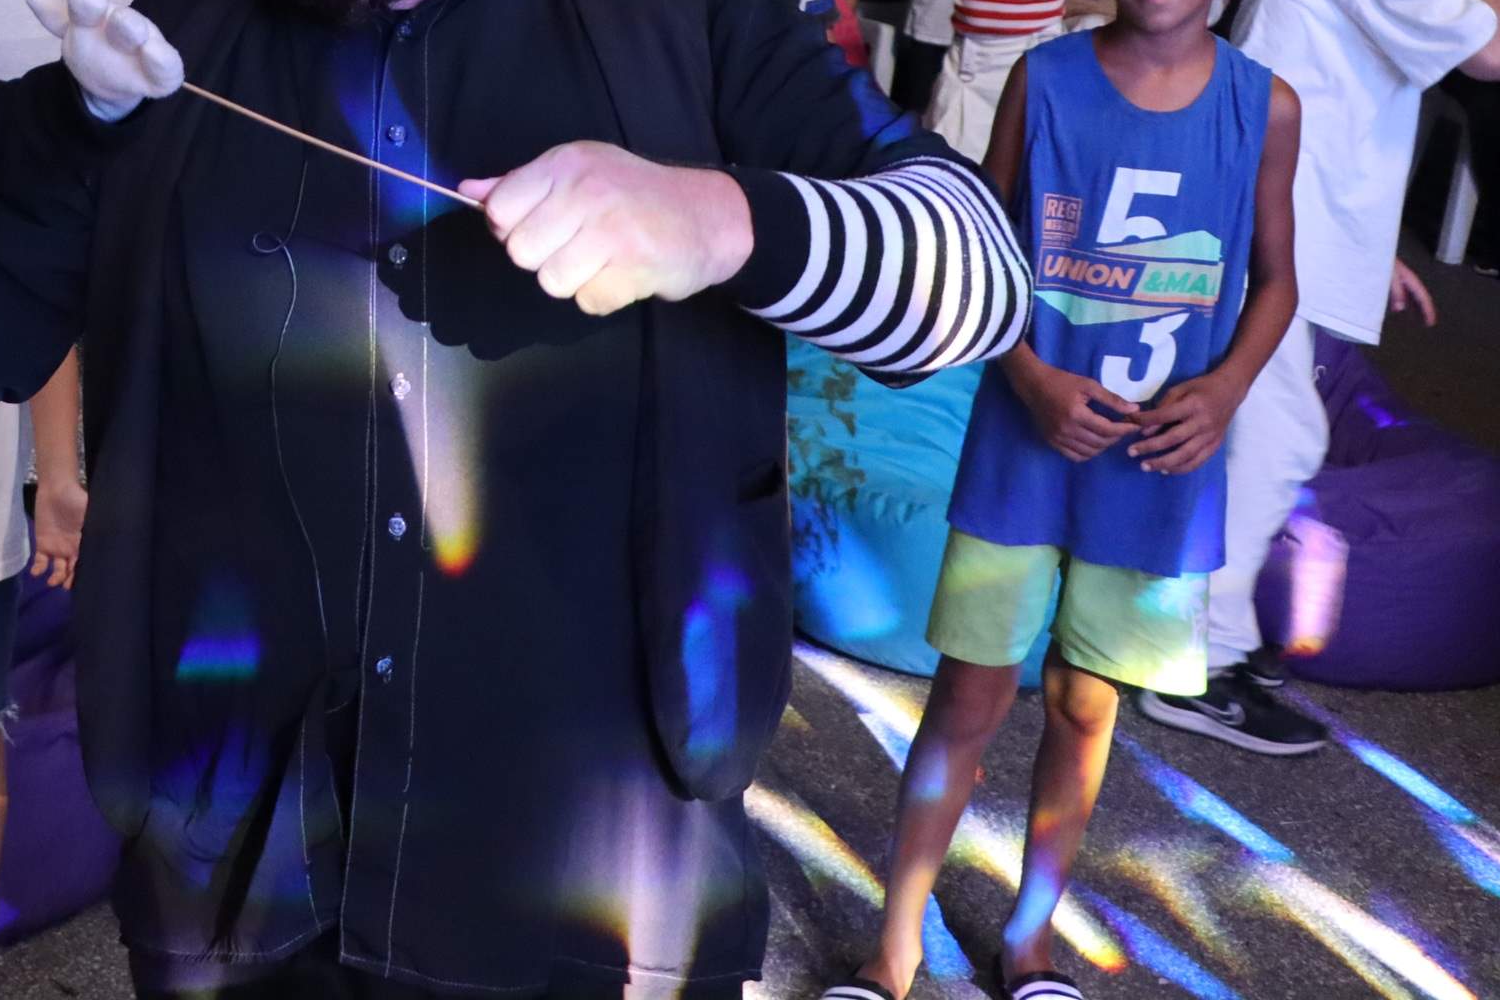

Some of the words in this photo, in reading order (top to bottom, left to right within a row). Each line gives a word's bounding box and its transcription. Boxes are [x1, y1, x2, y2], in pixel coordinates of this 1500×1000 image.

[1045, 198, 1078, 221] REG
[1095, 166, 1183, 244] 5
[1043, 254, 1136, 291] UNION
